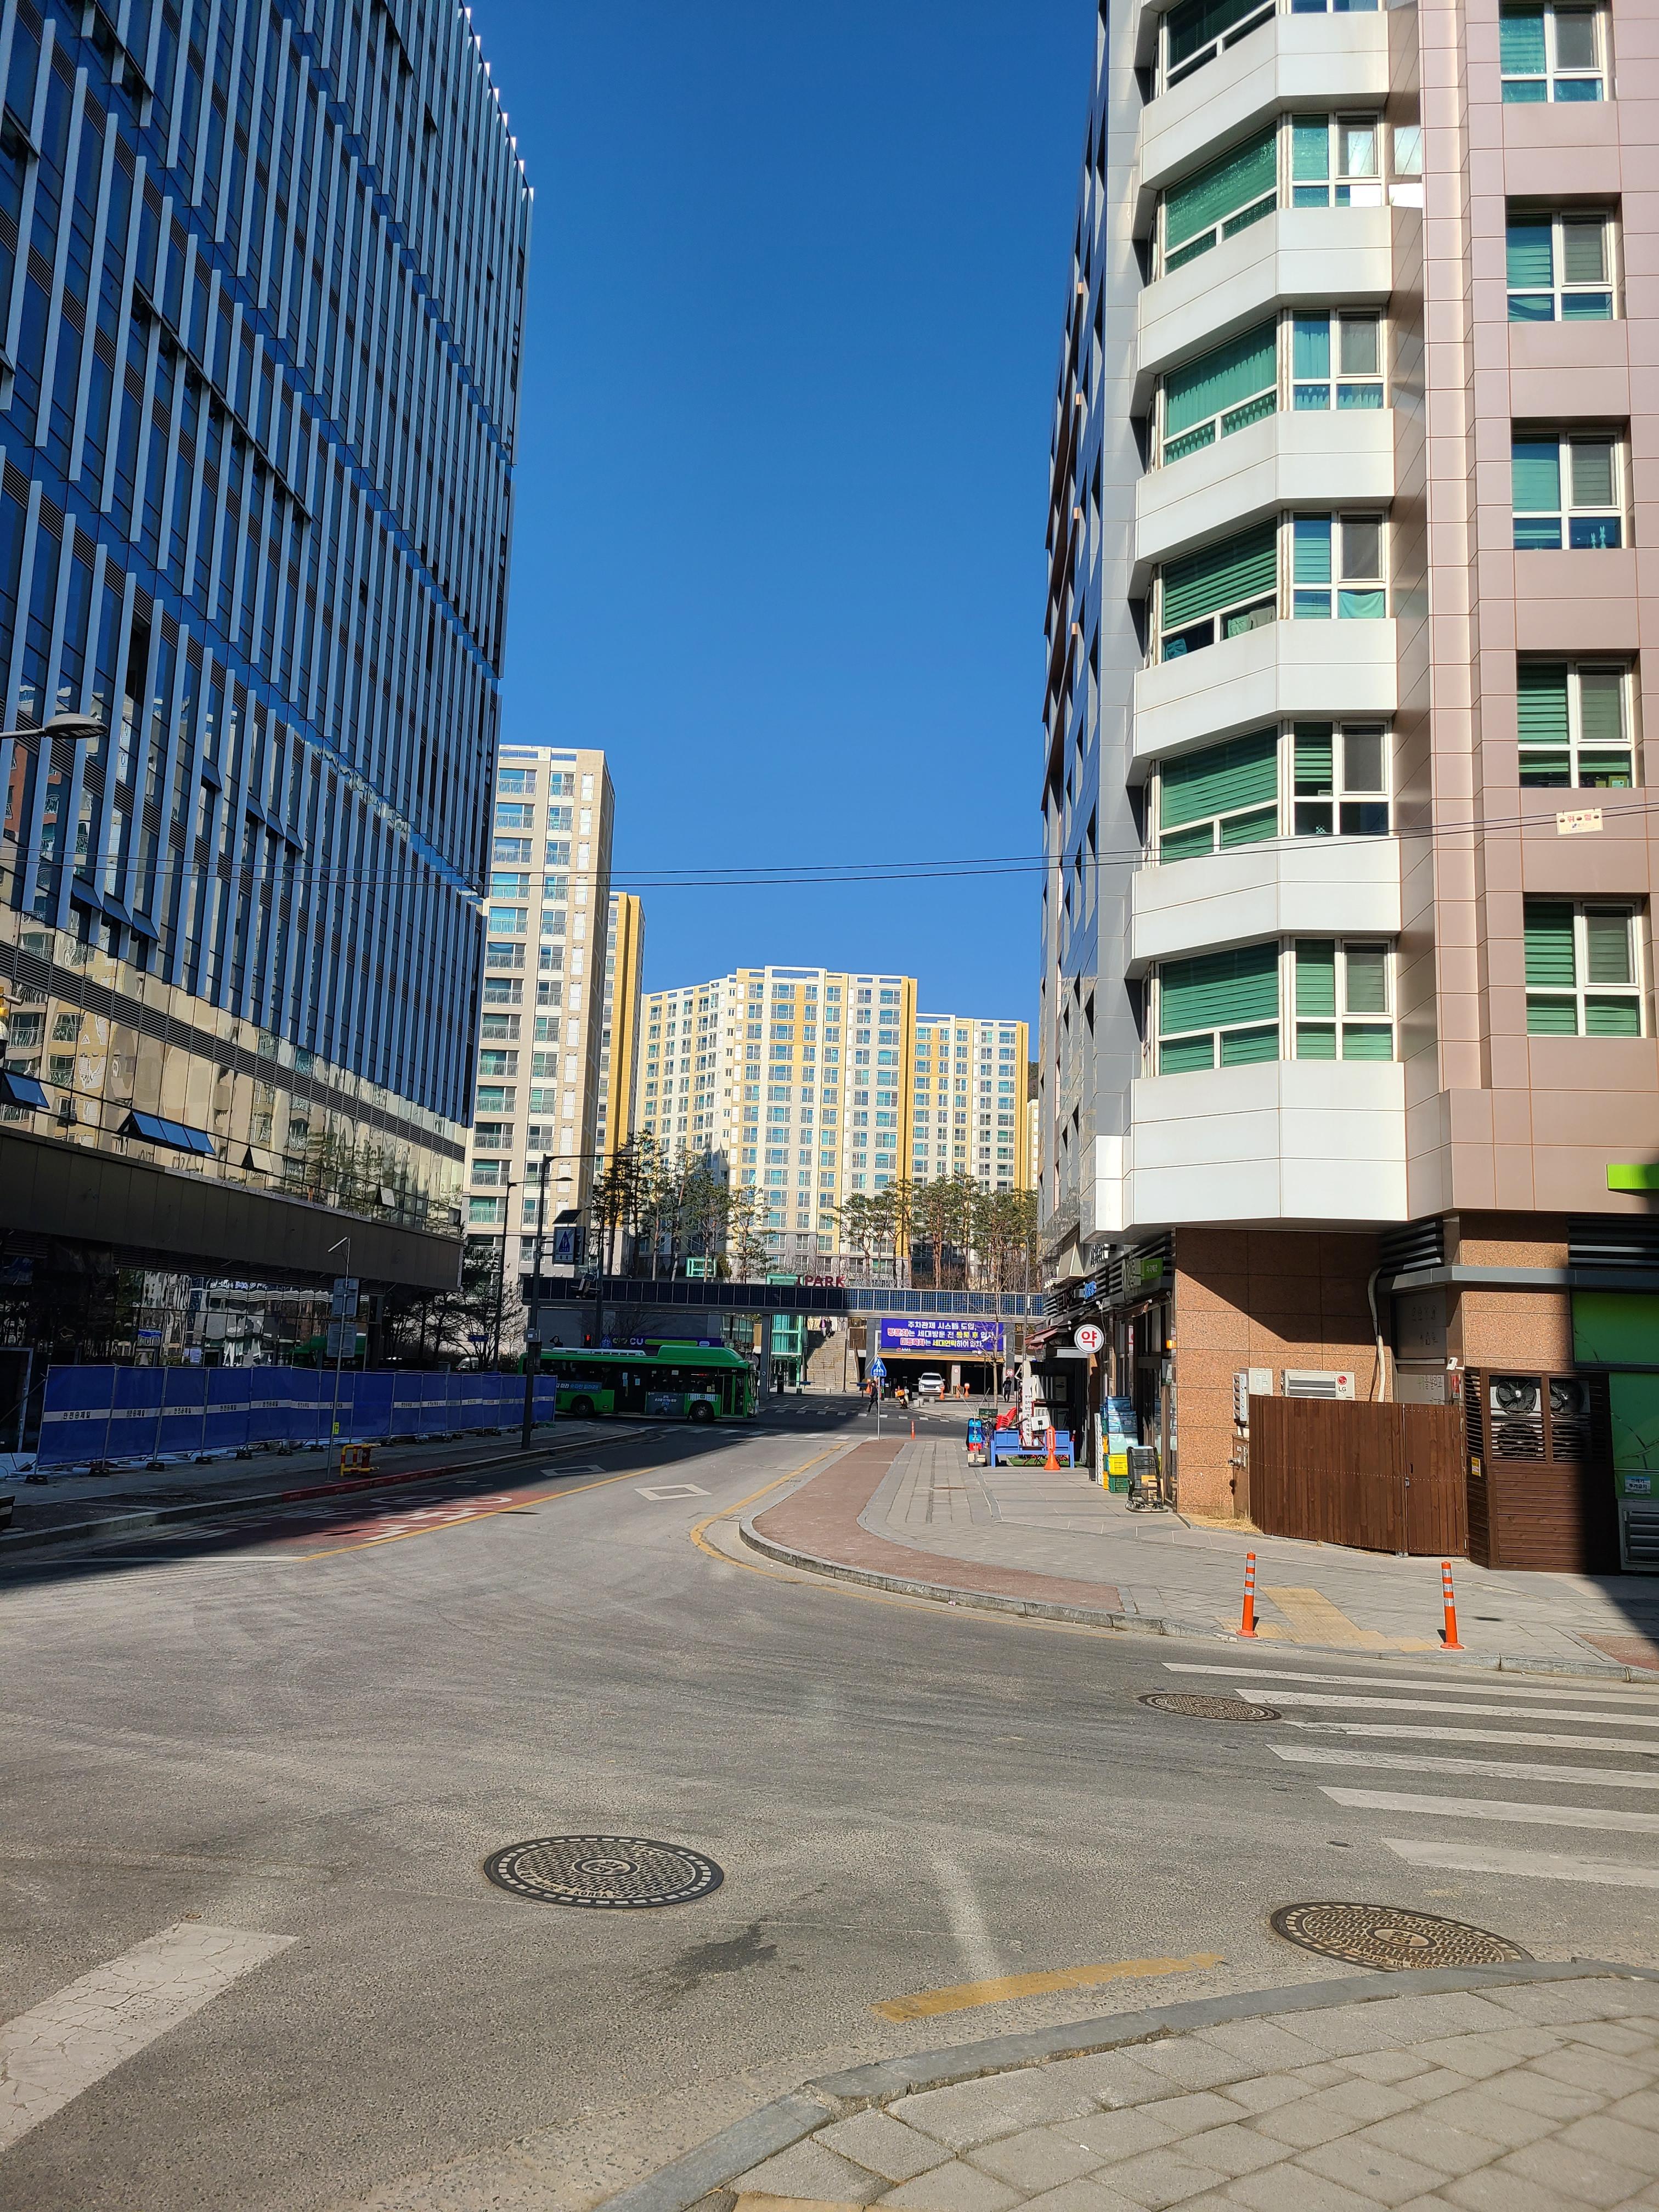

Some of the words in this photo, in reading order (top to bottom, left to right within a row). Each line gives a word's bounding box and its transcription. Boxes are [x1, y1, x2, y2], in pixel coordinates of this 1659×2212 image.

[907, 1321, 935, 1329] 주차관제
[938, 1322, 959, 1330] 시스템
[887, 1328, 915, 1337] 방문차는
[917, 1330, 946, 1338] 세대방문
[1081, 1330, 1097, 1348] 약
